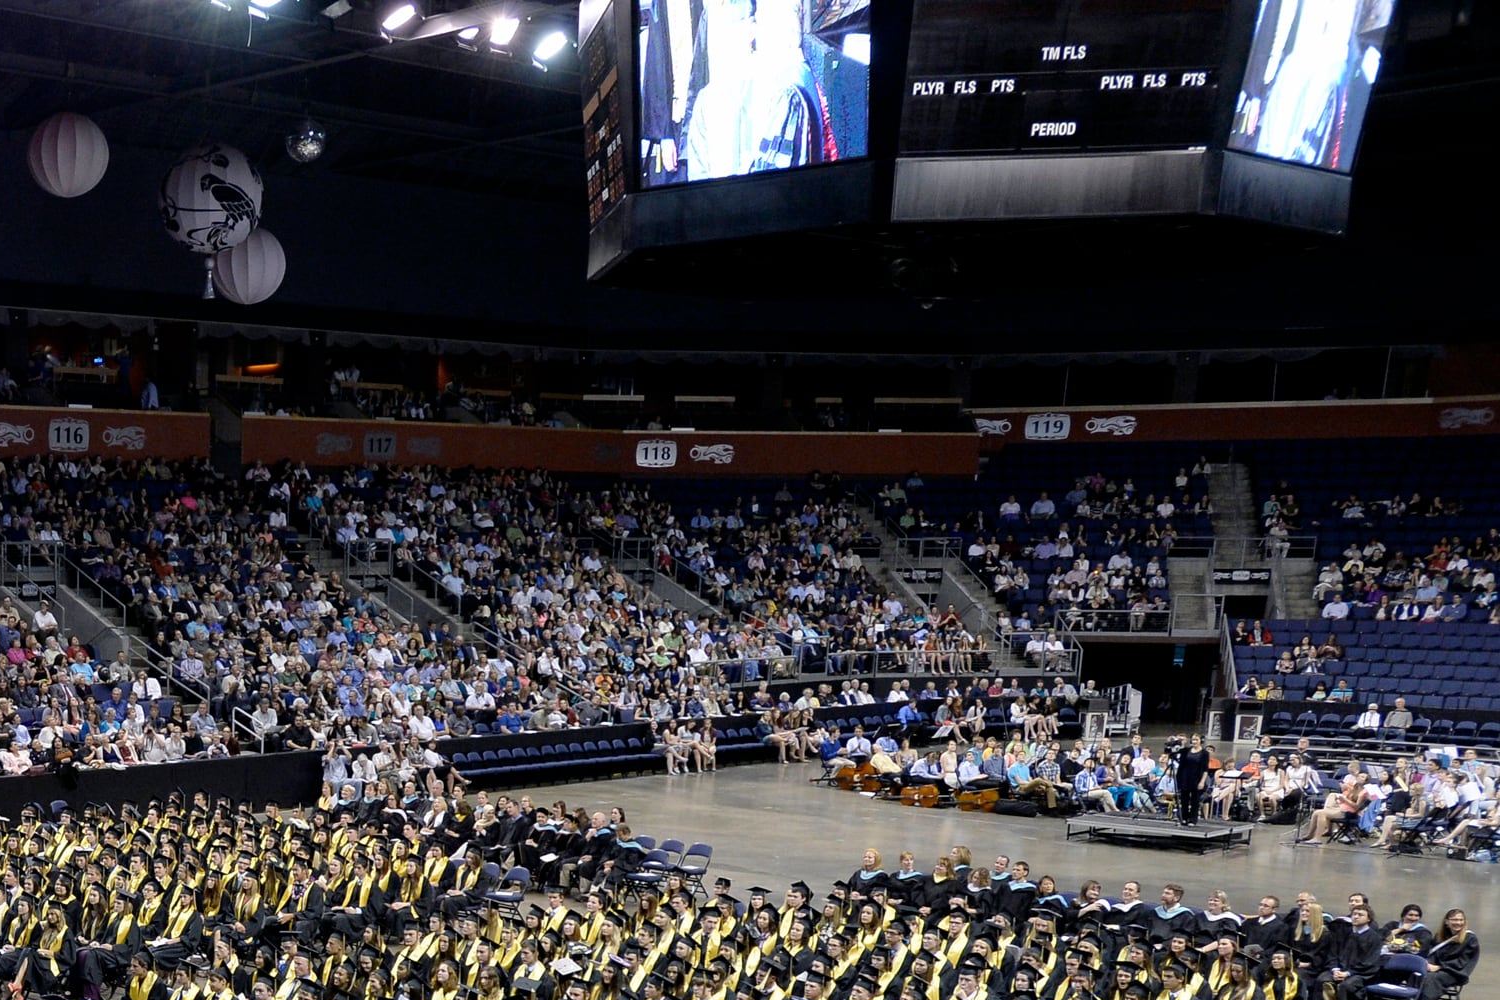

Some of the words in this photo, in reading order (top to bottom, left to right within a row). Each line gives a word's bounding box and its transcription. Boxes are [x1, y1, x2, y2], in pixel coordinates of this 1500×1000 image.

[1041, 46, 1061, 61] TM
[1063, 45, 1087, 60] FLS
[912, 81, 945, 96] PLYR
[953, 80, 977, 94] FLS
[990, 79, 1015, 93] PTS
[1100, 75, 1134, 90] PLYR
[1142, 73, 1167, 88] FLS
[1180, 72, 1207, 87] PTS
[1030, 121, 1077, 137] PERIOD
[1032, 419, 1064, 434] 119
[54, 426, 83, 444] 116
[368, 437, 392, 453] 117
[642, 446, 670, 461] 118
